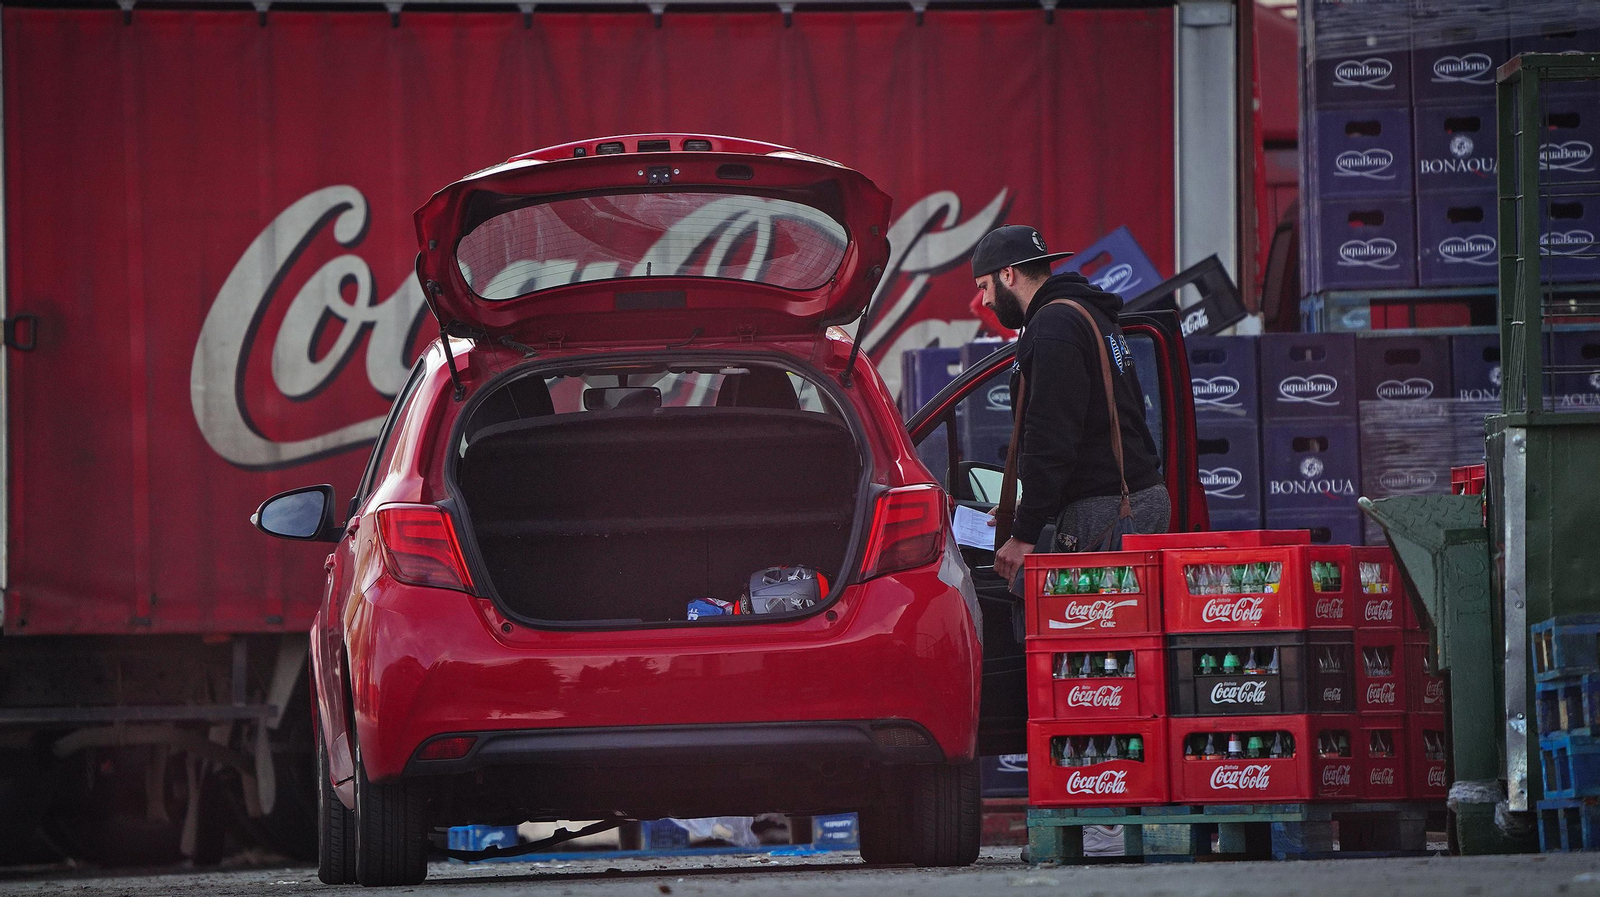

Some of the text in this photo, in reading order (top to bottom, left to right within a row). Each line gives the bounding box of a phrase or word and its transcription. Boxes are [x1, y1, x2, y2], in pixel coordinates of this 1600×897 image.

[1338, 62, 1388, 77] aquaBona
[1436, 60, 1487, 74] aquaBona
[1339, 155, 1388, 170] aquaBona
[1342, 243, 1391, 258] aquaBona
[1441, 240, 1491, 255] aquaBona
[1192, 383, 1234, 396] quaBona
[1282, 379, 1333, 394] aquaBona
[1379, 381, 1430, 397] aquaBona
[1270, 479, 1355, 497] BONAQUA
[1065, 600, 1115, 620] Coca-Cola
[1202, 597, 1265, 622] Coca-Cola
[1315, 598, 1344, 618] Coca-Cola
[1364, 599, 1394, 621] Coca-Cola
[1067, 685, 1123, 707] Coca-Cola
[1211, 681, 1268, 704] Coca-Cola
[1323, 687, 1342, 701] Coca-Cola
[1366, 682, 1396, 704] Coca-Cola
[1066, 770, 1128, 795] Coca-Cola
[1210, 764, 1272, 789] Coca-Cola
[1322, 765, 1351, 786] Coca-Cola
[1370, 767, 1394, 785] Coca-Cola
